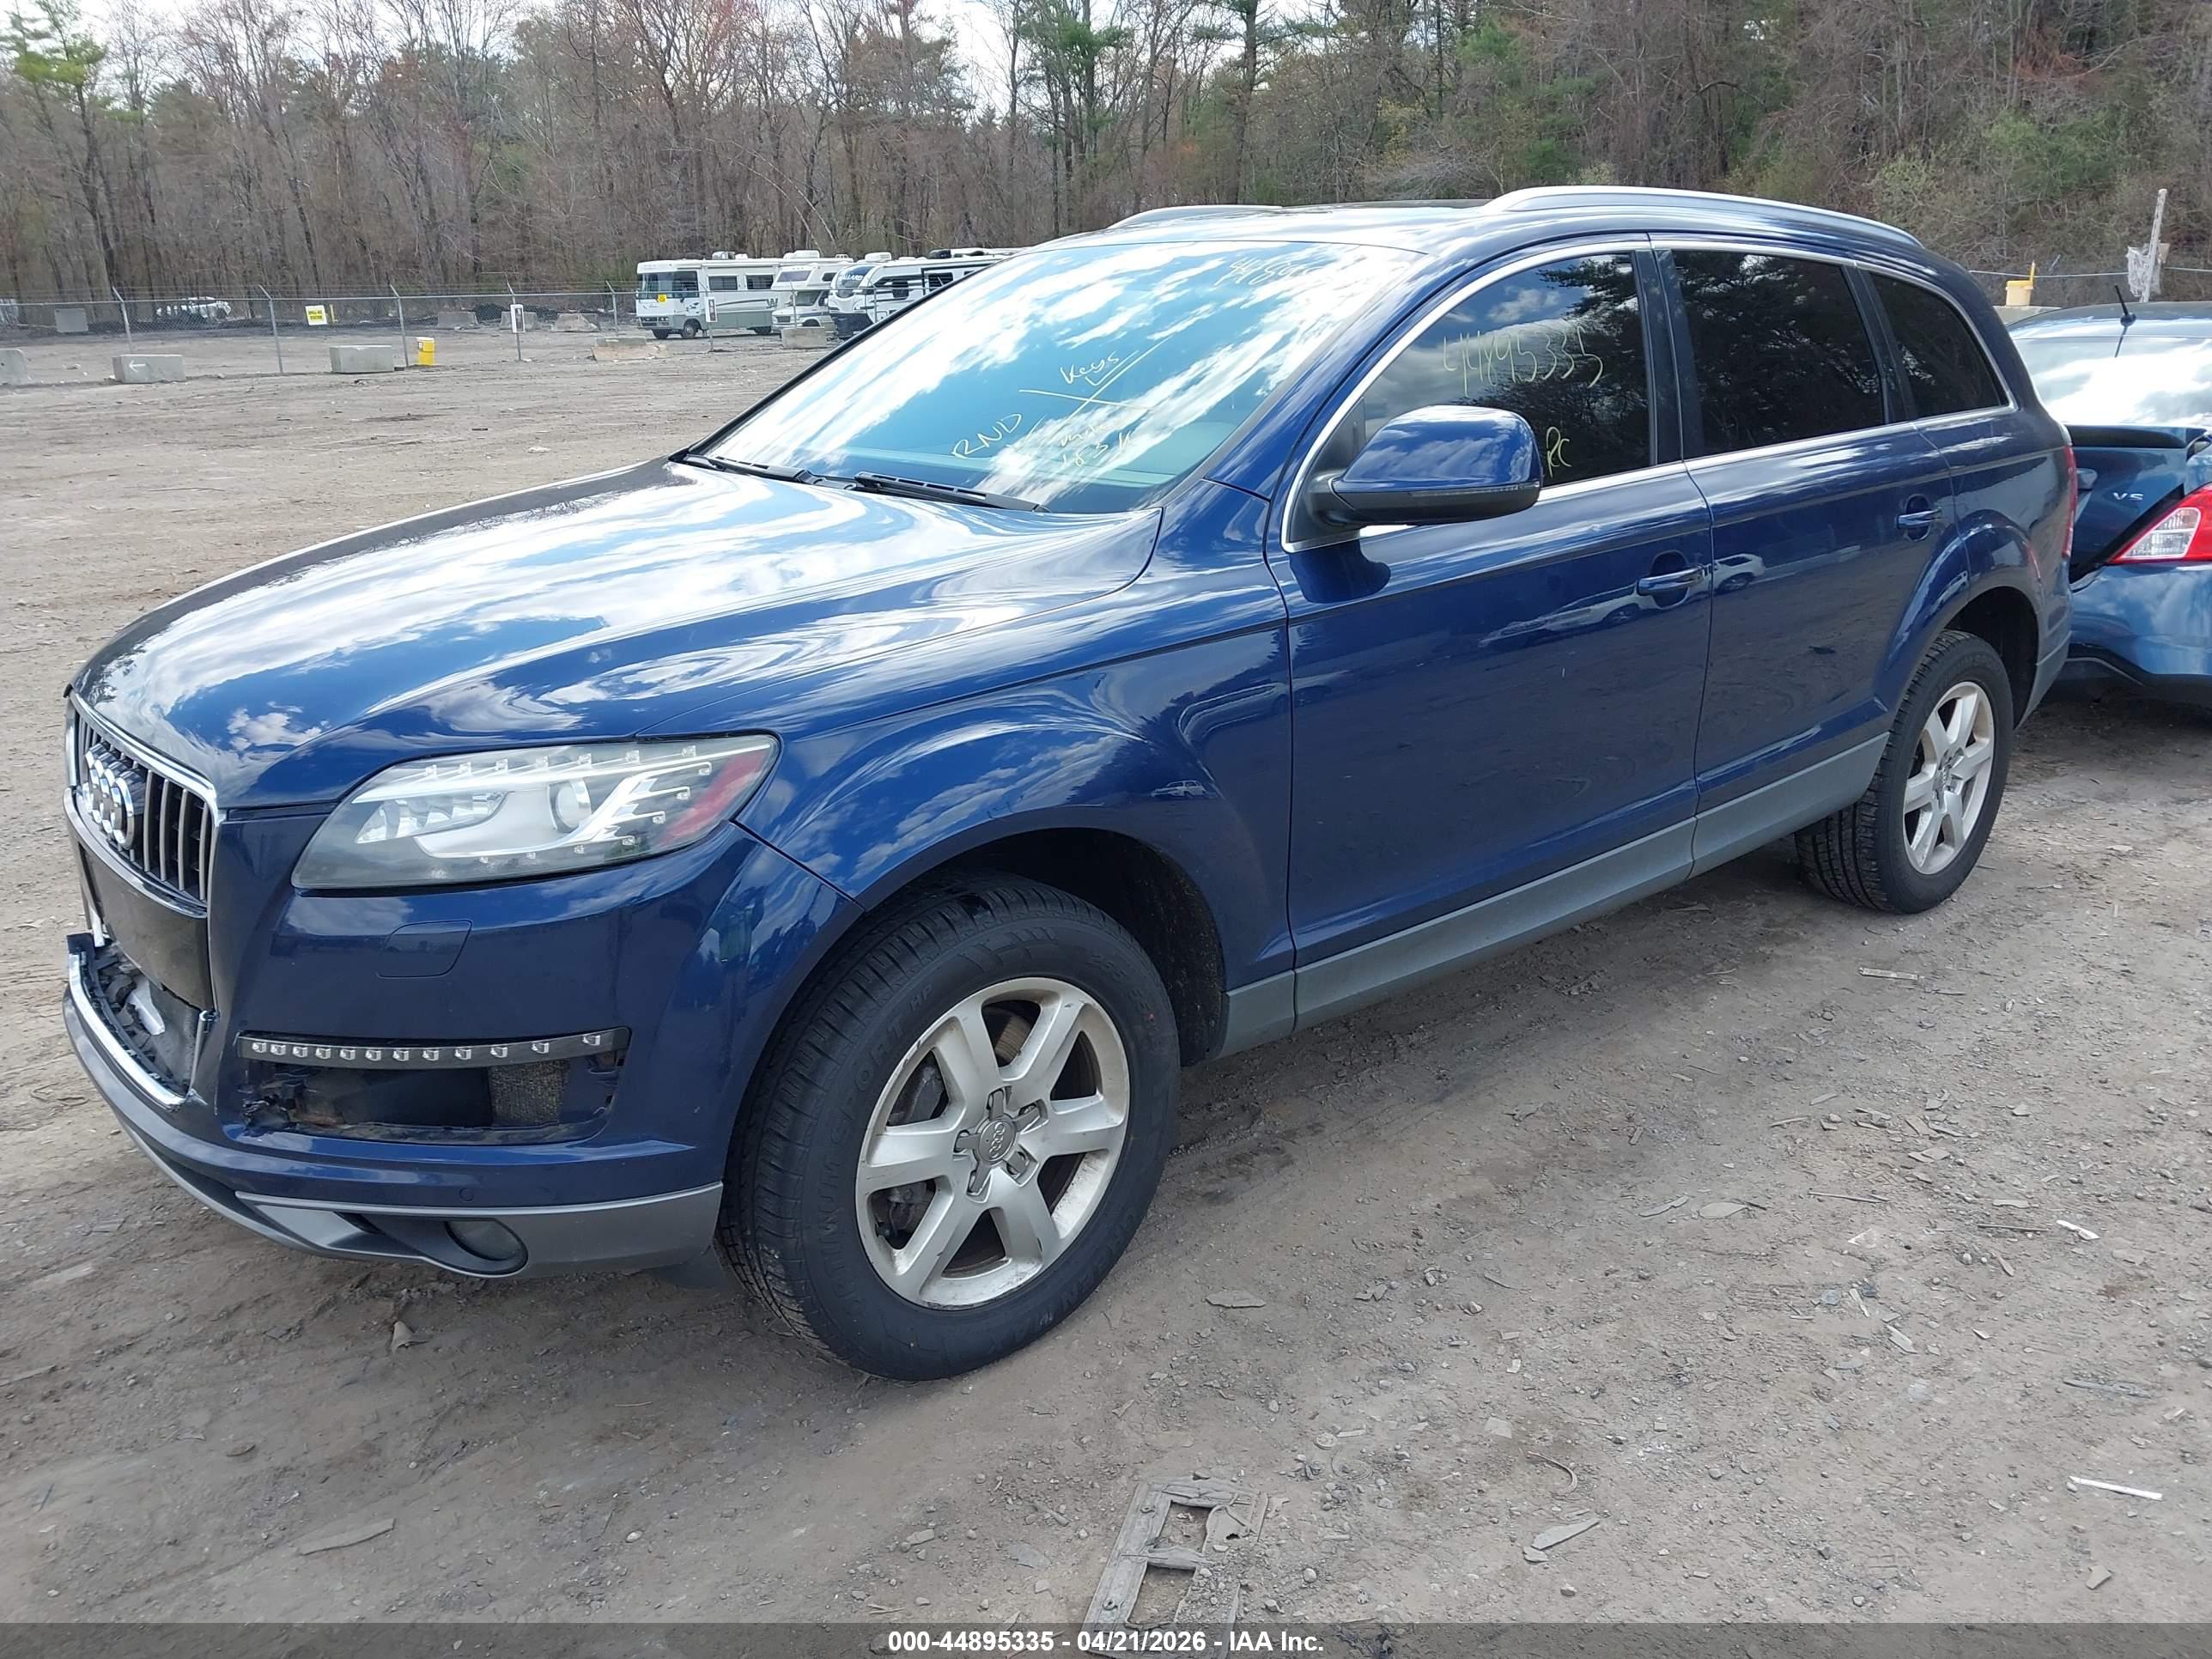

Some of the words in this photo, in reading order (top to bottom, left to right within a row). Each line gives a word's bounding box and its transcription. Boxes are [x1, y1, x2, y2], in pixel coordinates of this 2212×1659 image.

[1060, 350, 1120, 385] Keys
[1443, 325, 1603, 398] 44895335
[951, 412, 1023, 459] RND
